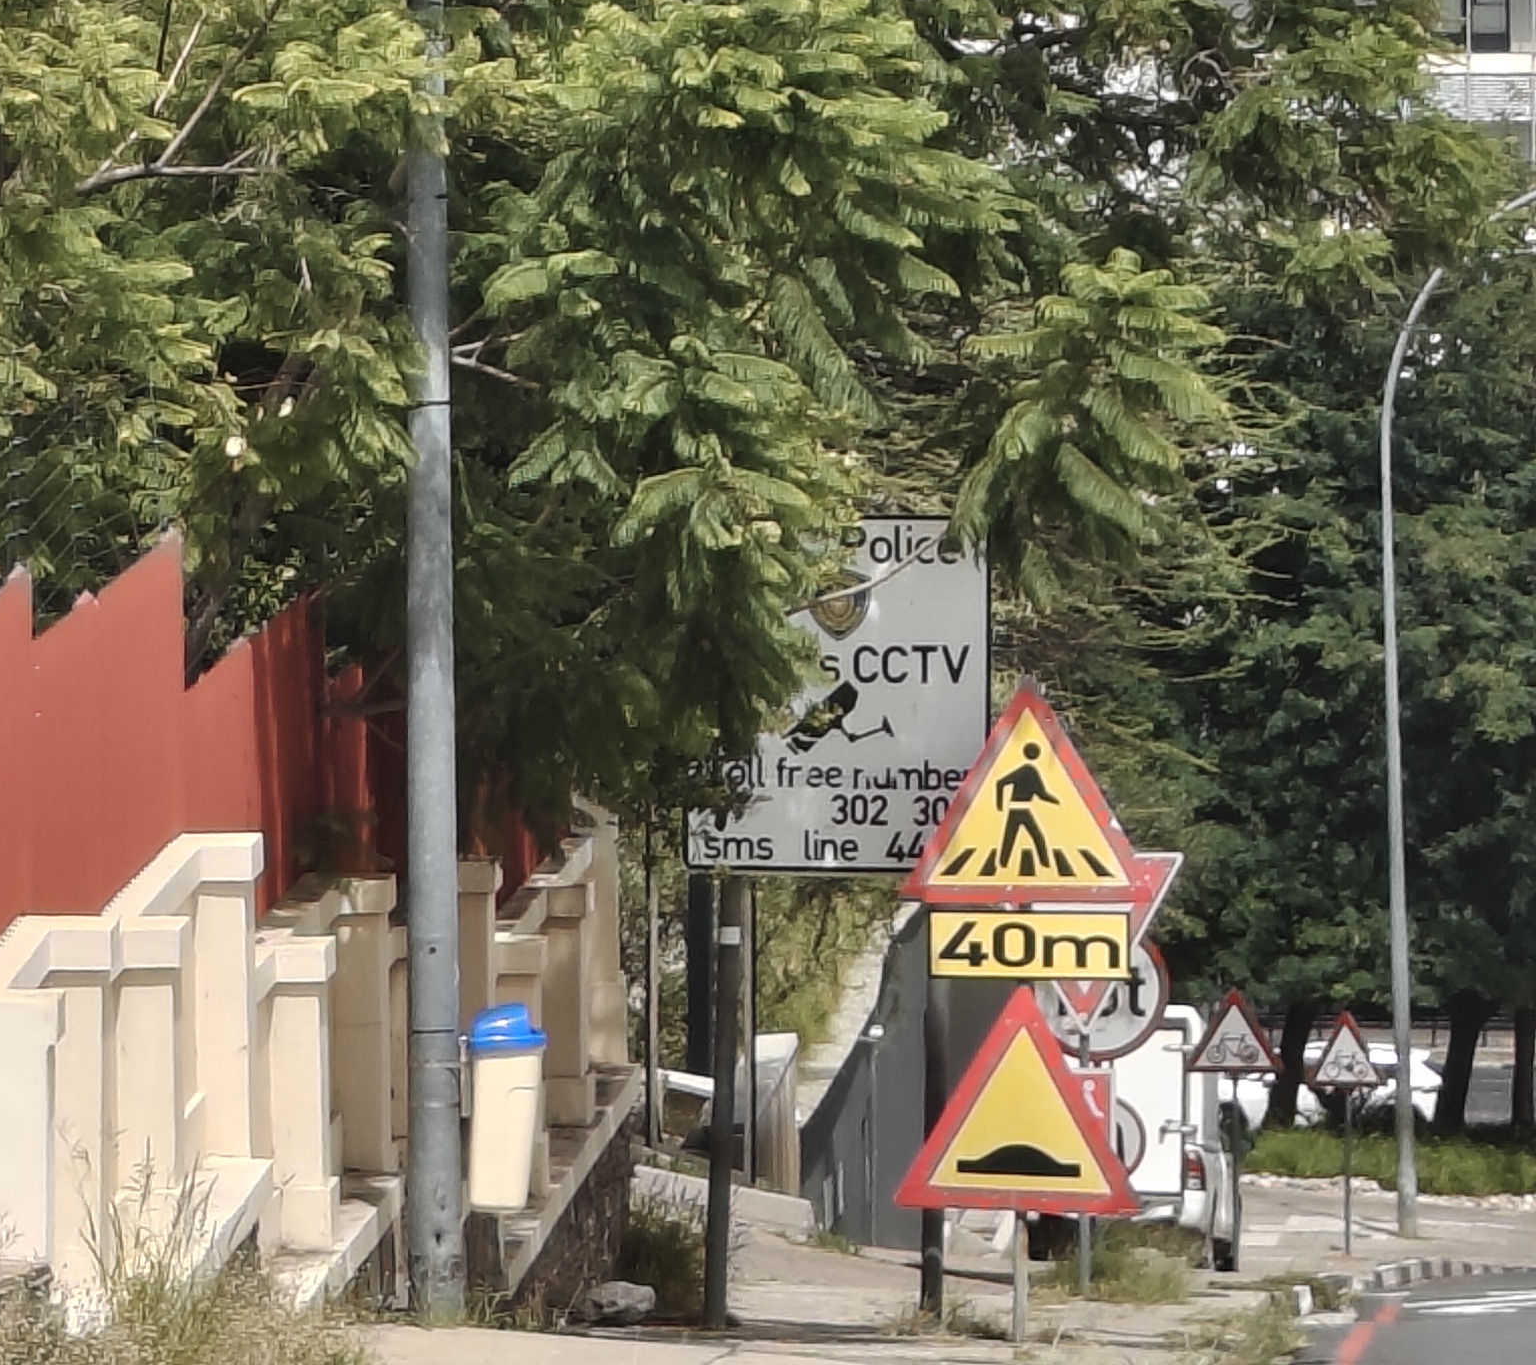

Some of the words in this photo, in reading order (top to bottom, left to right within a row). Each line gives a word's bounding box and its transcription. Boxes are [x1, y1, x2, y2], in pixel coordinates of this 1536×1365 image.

[852, 643, 971, 685] CCTV
[776, 756, 843, 789] free
[830, 793, 889, 826] 302
[703, 835, 774, 861] sms
[804, 829, 859, 861] line
[938, 919, 1121, 969] 40m
